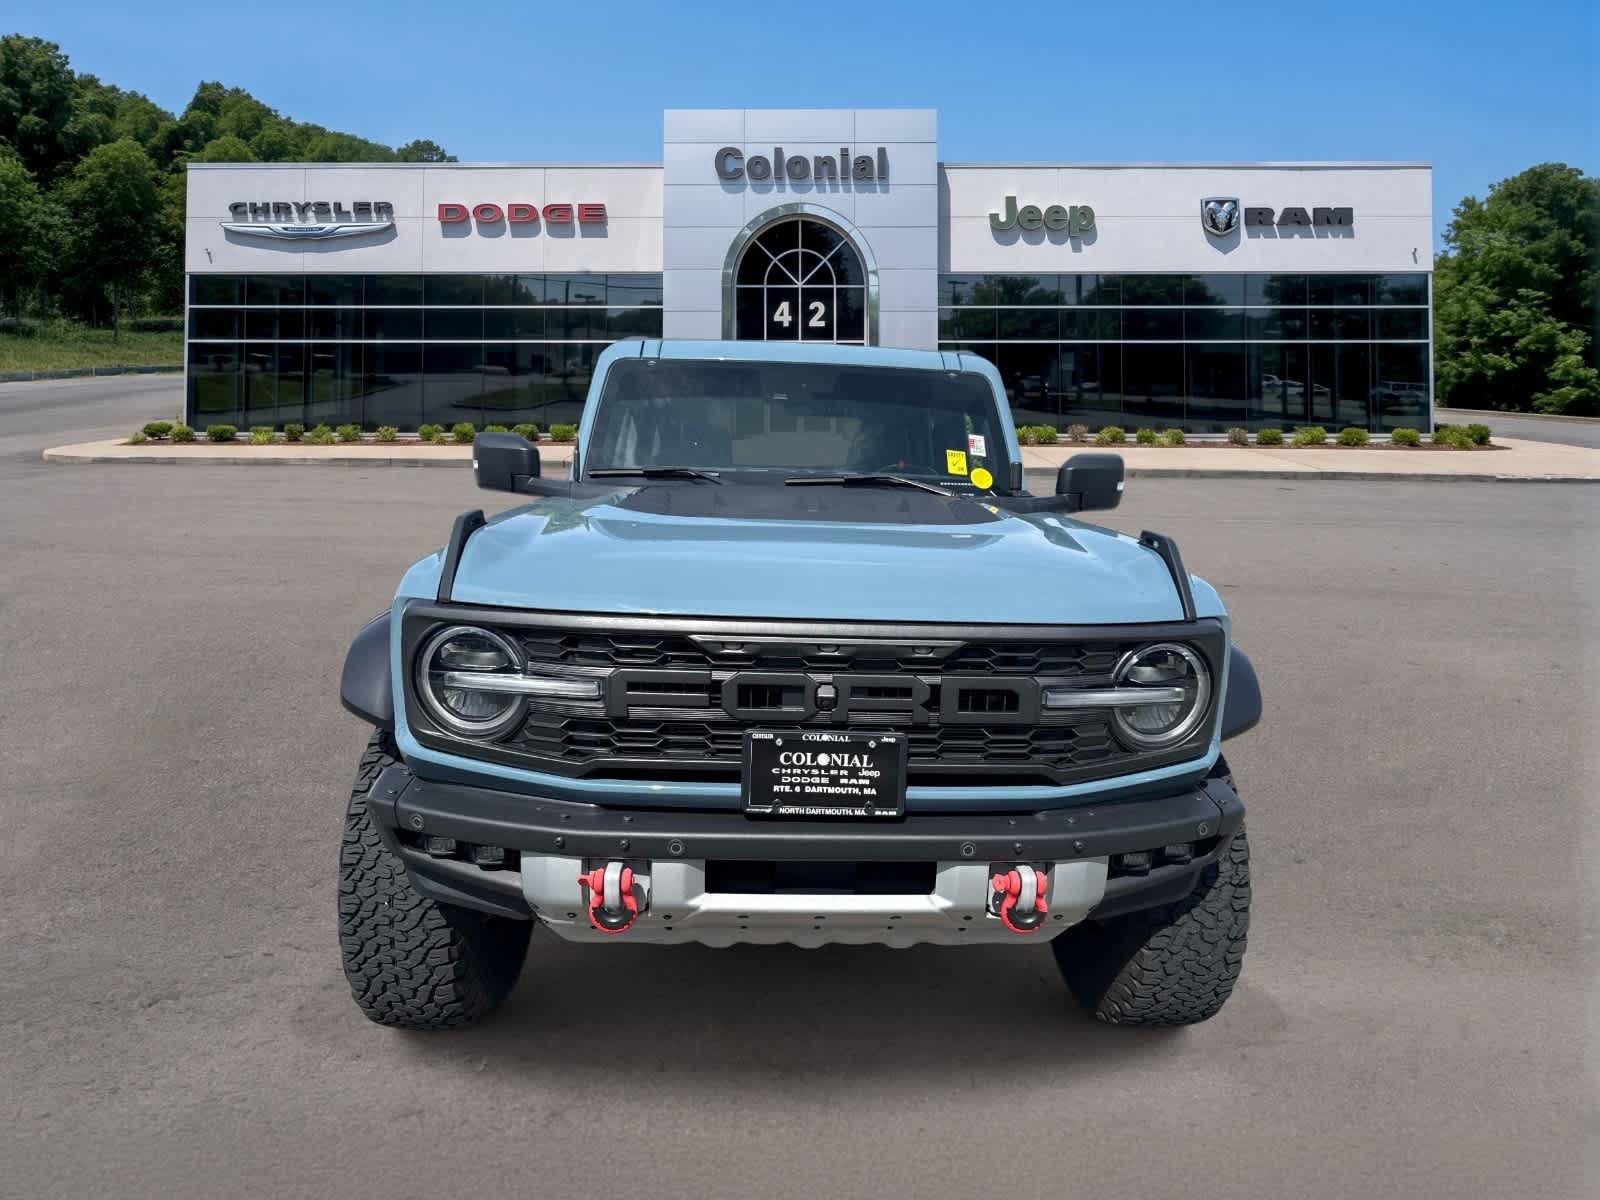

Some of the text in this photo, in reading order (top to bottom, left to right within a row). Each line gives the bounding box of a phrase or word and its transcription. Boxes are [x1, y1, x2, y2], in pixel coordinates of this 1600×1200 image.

[714, 147, 888, 180] Colonial
[228, 201, 394, 215] CHRYSLER
[438, 203, 606, 222] DODGE
[989, 196, 1096, 238] Jeep
[1244, 206, 1354, 226] RAM
[607, 668, 1040, 725] FORD
[802, 733, 851, 743] COLONIAL
[779, 752, 874, 768] COLONIAL
[771, 768, 881, 778] CHRYSLER Jeep
[781, 776, 830, 784] DODGE
[773, 785, 793, 793] RTE.
[863, 787, 877, 795] MA
[779, 807, 805, 815] NORTH
